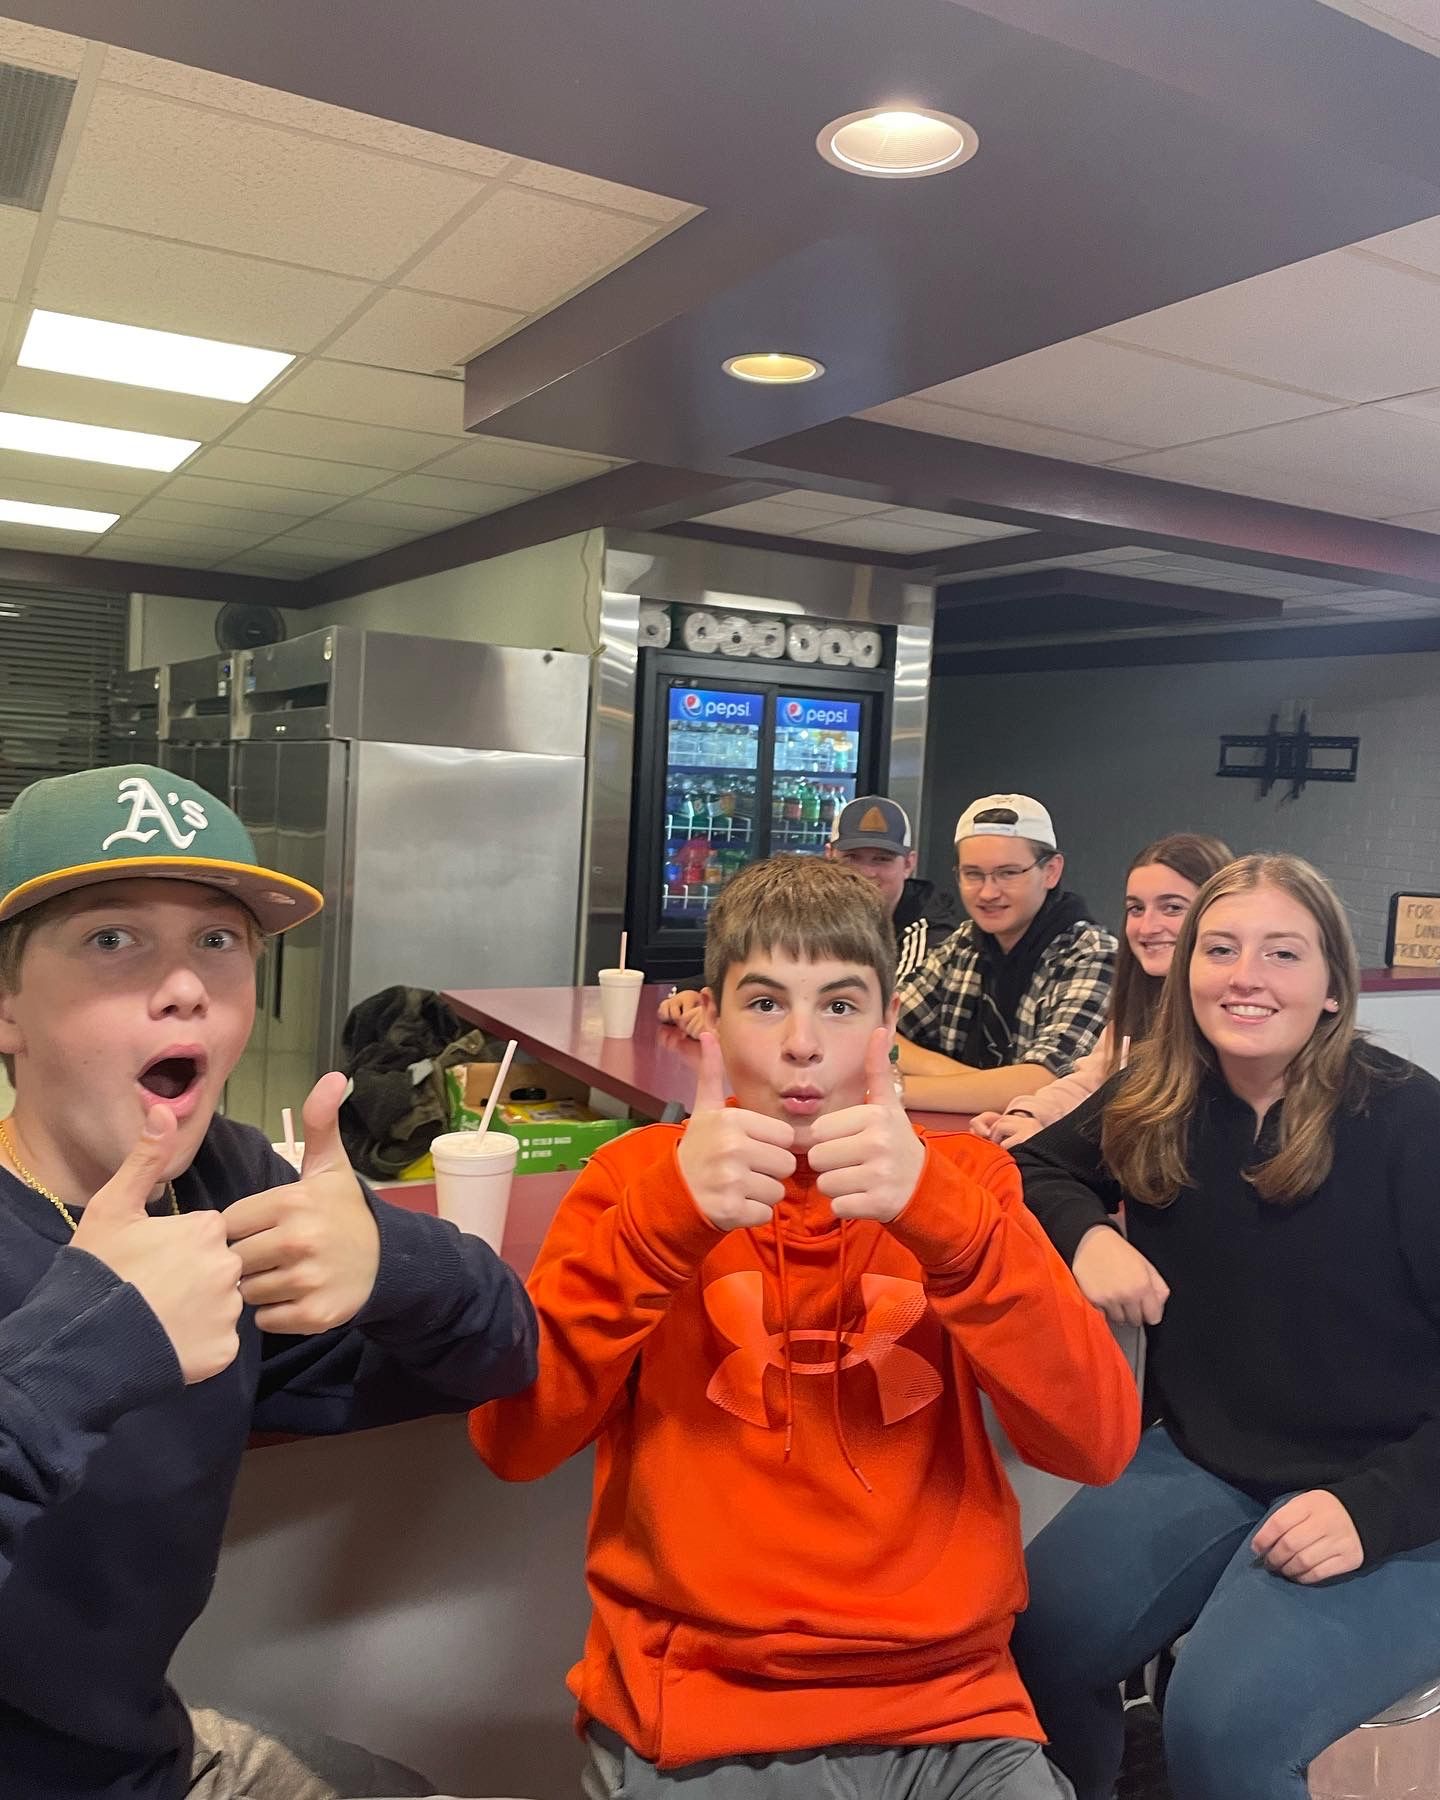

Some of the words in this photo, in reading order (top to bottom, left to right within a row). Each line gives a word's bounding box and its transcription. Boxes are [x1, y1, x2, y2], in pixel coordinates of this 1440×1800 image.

[705, 702, 751, 719] pepsi
[805, 709, 849, 726] pepsi
[101, 777, 209, 851] A's
